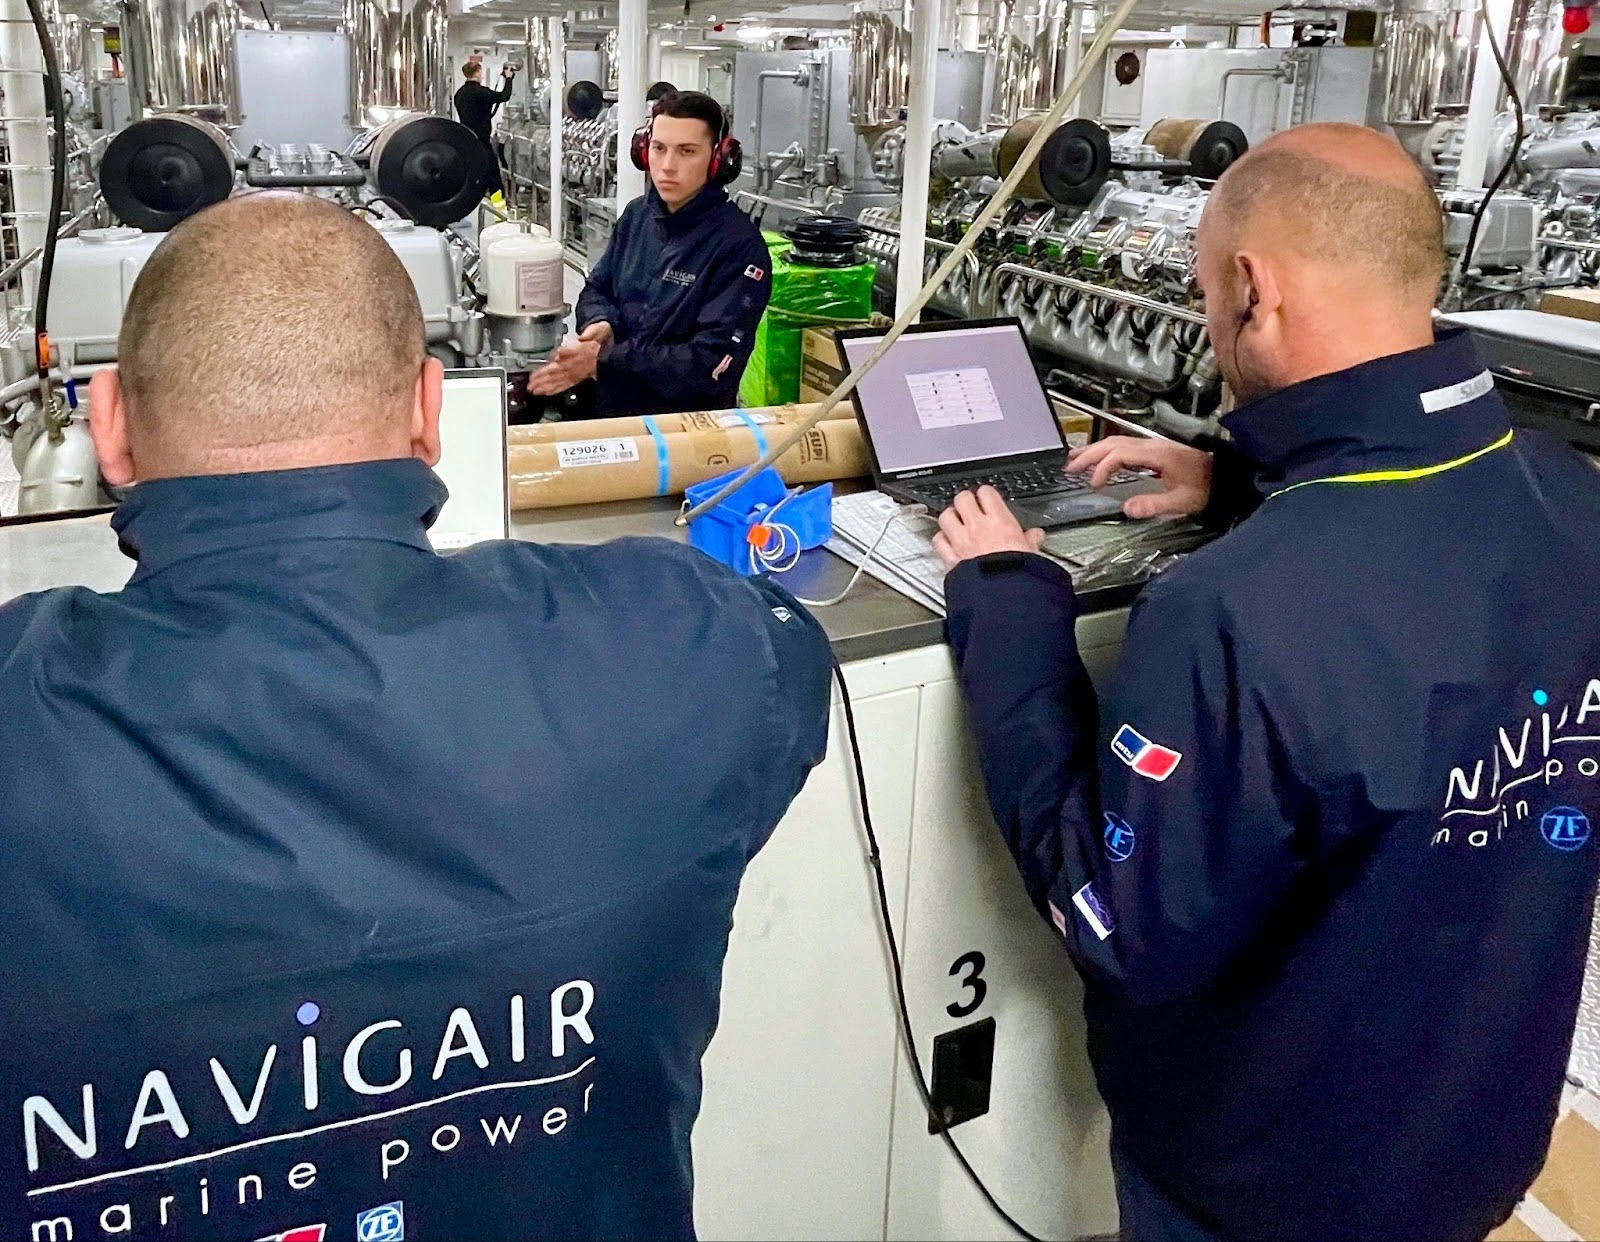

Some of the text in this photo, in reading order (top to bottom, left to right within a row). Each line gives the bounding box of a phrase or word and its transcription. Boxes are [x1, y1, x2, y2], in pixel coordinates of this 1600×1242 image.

[562, 444, 607, 456] 129026
[945, 951, 988, 1018] 3
[24, 980, 596, 1171] NAVIGAIR
[32, 1084, 595, 1241] marine power
